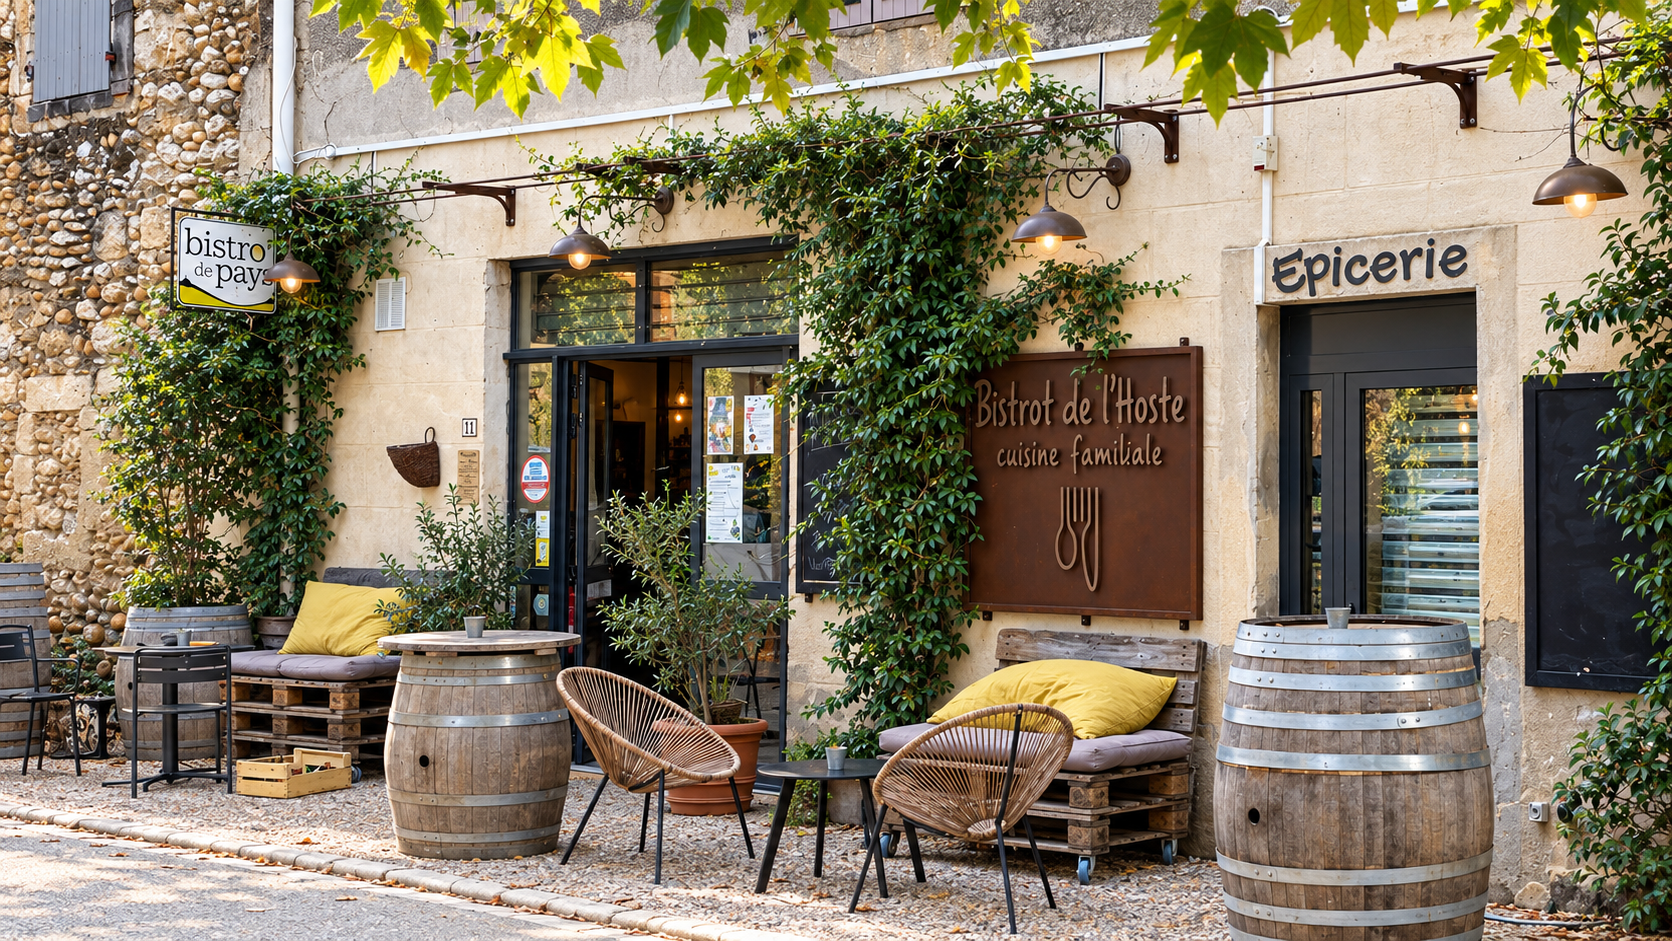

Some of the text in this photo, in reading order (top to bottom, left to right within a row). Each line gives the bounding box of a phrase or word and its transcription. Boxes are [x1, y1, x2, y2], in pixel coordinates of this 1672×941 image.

[185, 227, 266, 262] bistro
[194, 261, 213, 278] de
[1271, 237, 1468, 297] Epicerie
[974, 373, 1186, 428] Bistrot de l'Hoste
[464, 421, 475, 435] 11
[996, 441, 1060, 468] cuisine
